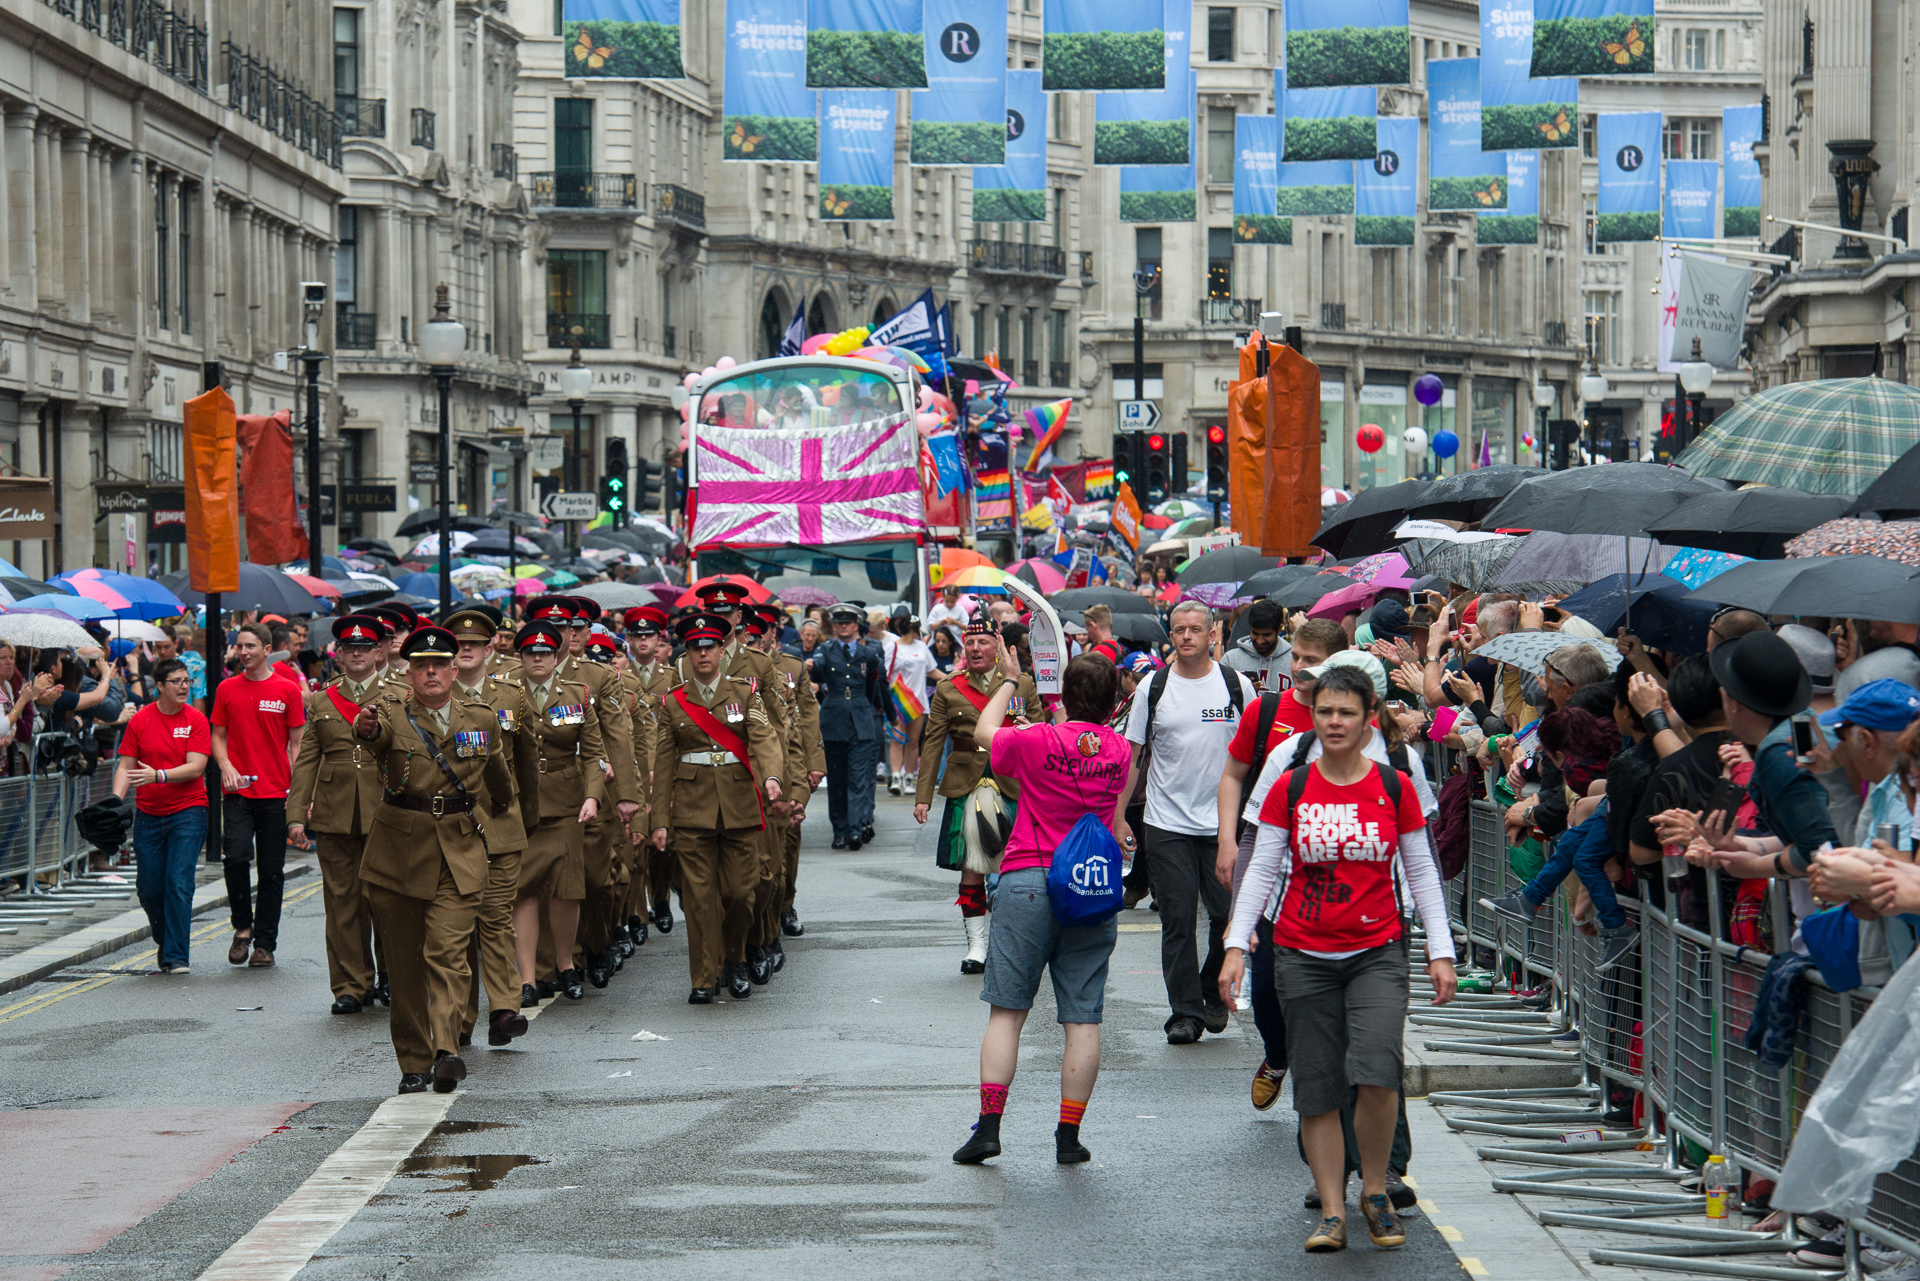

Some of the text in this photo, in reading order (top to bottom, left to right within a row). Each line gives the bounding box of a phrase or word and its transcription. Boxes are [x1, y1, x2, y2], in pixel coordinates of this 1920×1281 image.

[1490, 9, 1533, 24] Sum
[1495, 24, 1533, 38] stre
[740, 36, 804, 51] streets
[949, 30, 974, 55] R
[829, 105, 890, 119] Summer
[1437, 100, 1481, 112] Summ
[833, 118, 883, 131] streets
[1442, 111, 1481, 124] stree
[1380, 154, 1394, 172] R
[1623, 149, 1638, 167] R
[1686, 306, 1736, 321] BANANA
[1681, 317, 1738, 334] REPUBLIC
[346, 494, 392, 504] FURLA
[0, 507, 45, 522] Clarks
[155, 510, 185, 525] CAMPE
[565, 508, 588, 516] Arch
[259, 700, 286, 711] ssafa
[1044, 754, 1122, 781] STEWARD
[1298, 803, 1358, 823] SOME
[1297, 822, 1380, 843] PEOPLE
[1299, 841, 1390, 863] ARE GAY.
[1072, 856, 1109, 886] citi
[1068, 883, 1113, 896] citibank.co.uk
[1302, 882, 1353, 903] OVER
[1298, 900, 1321, 922] IT!
